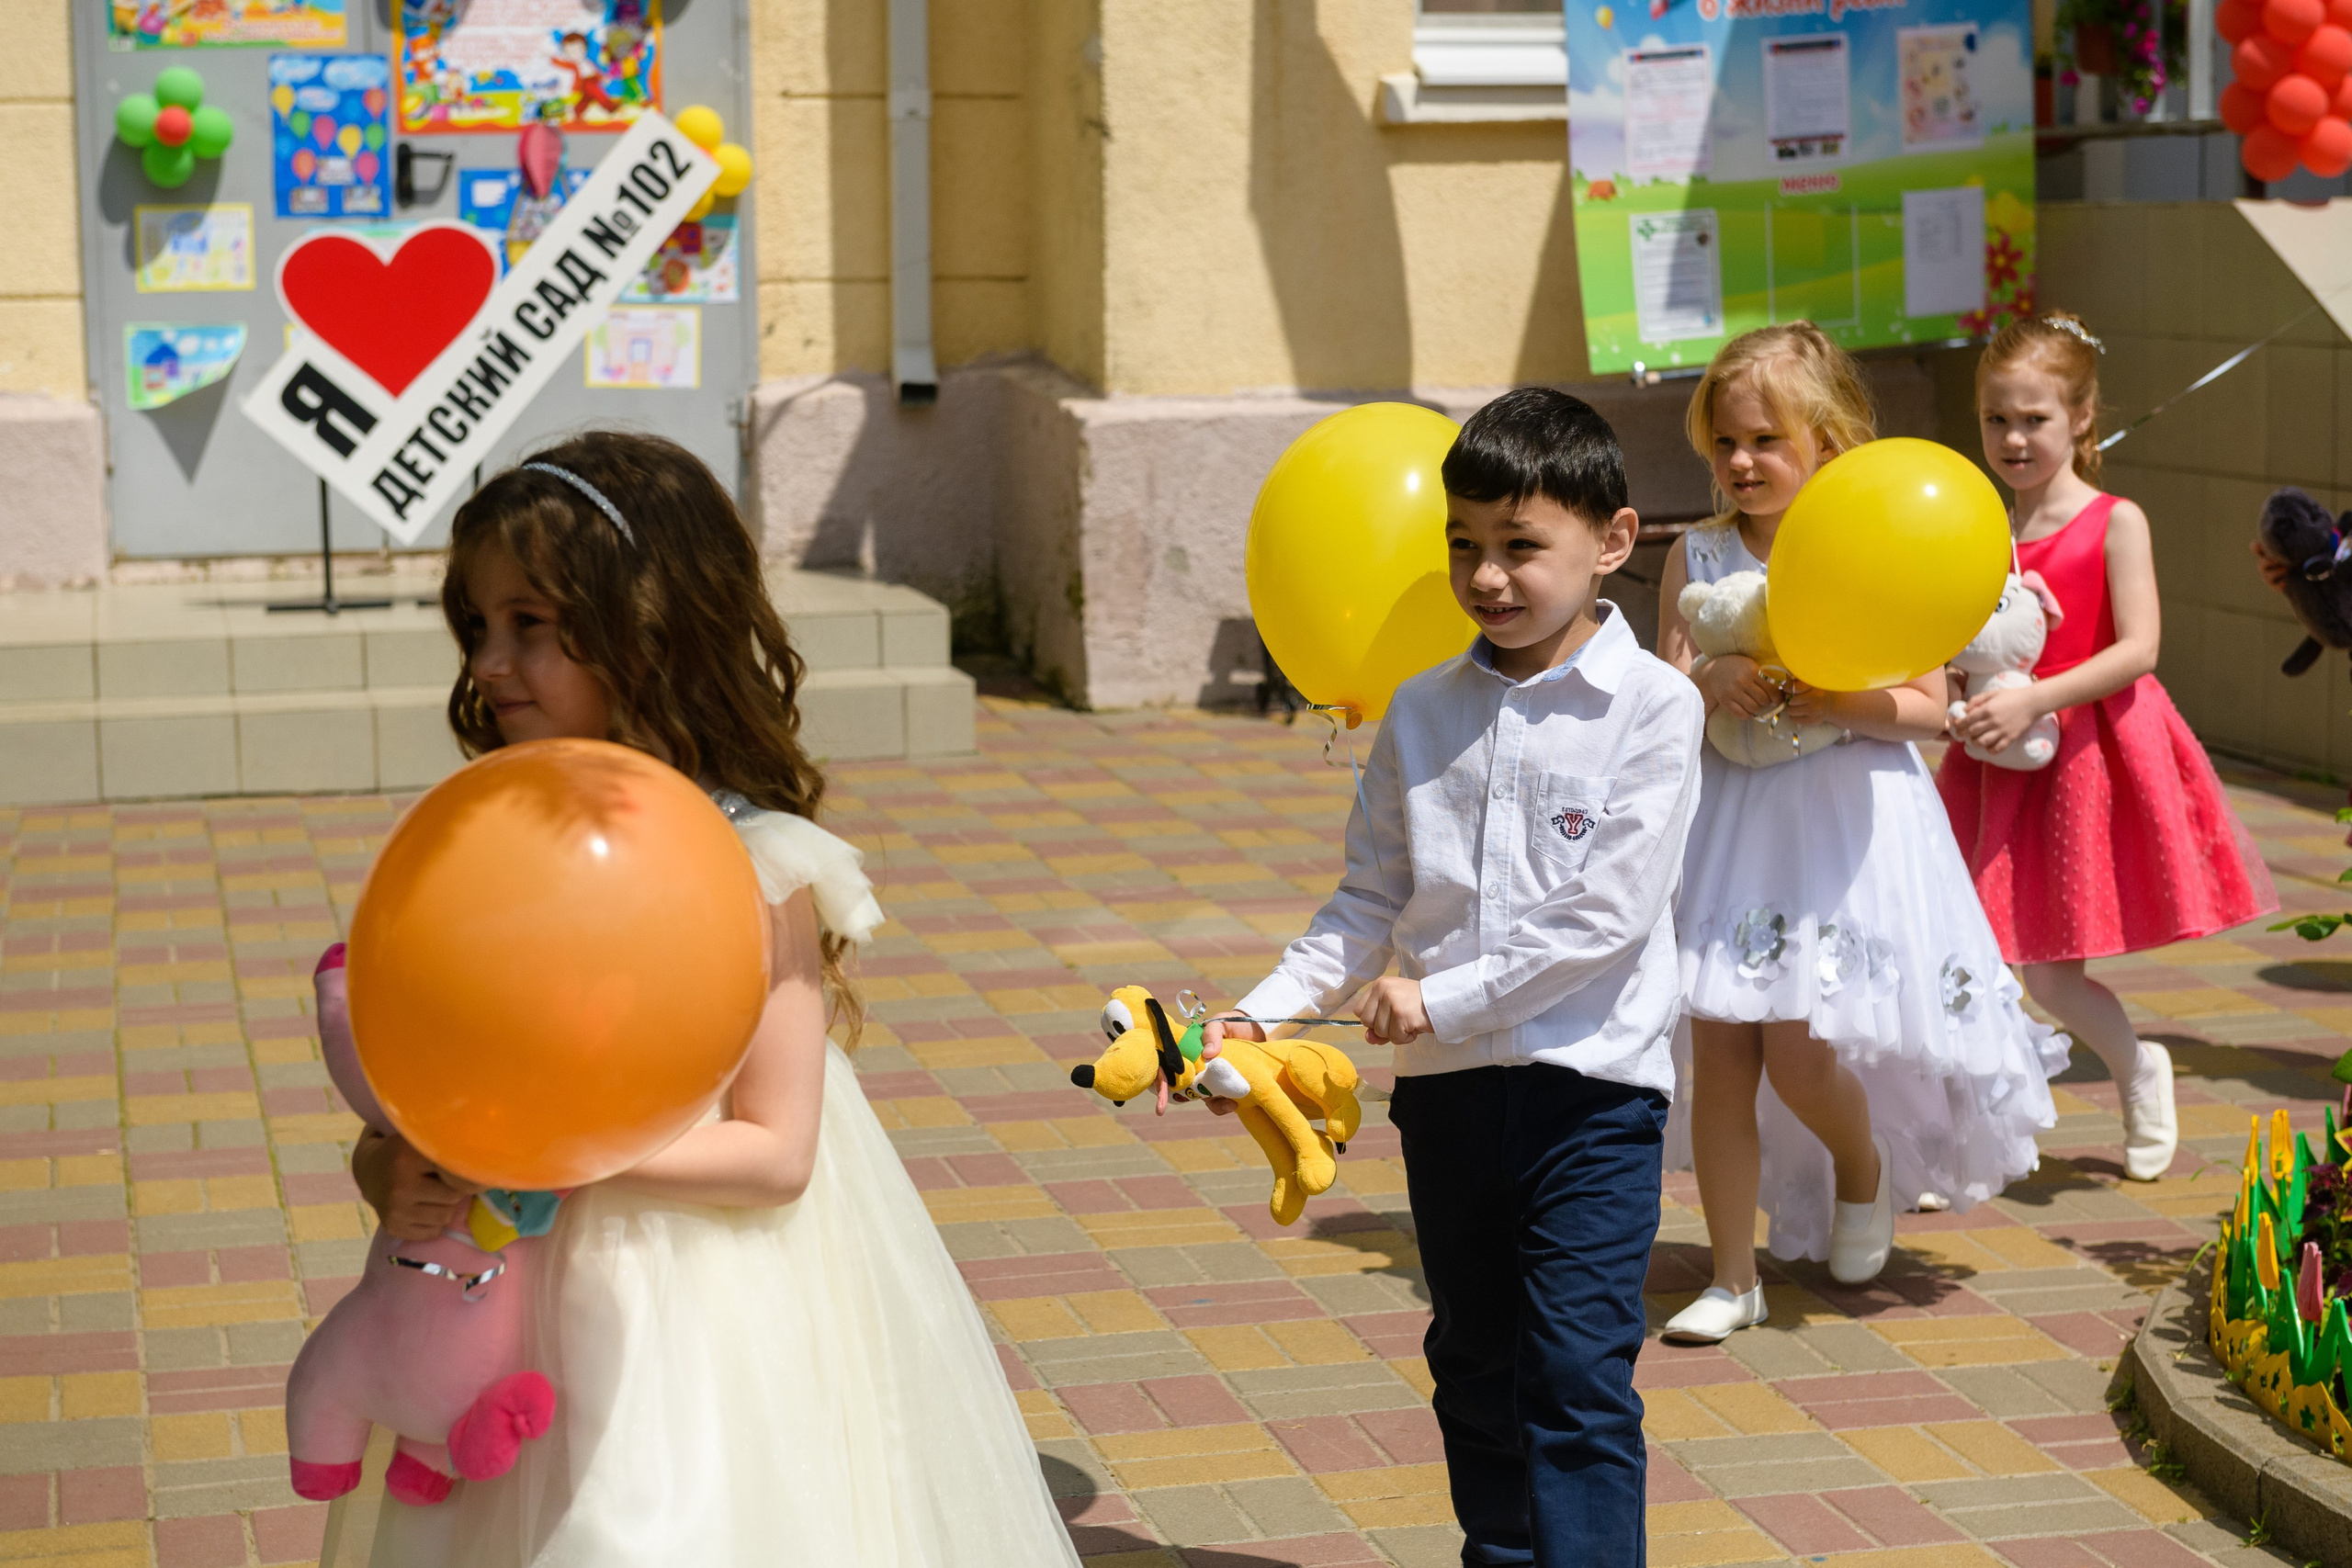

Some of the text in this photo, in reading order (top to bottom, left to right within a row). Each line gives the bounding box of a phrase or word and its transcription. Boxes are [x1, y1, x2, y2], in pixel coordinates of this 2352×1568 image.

[280, 362, 379, 458] Я
[371, 326, 531, 521] ДЕТСКИЙ
[514, 249, 607, 340] САД
[1565, 813, 1583, 834] Y
